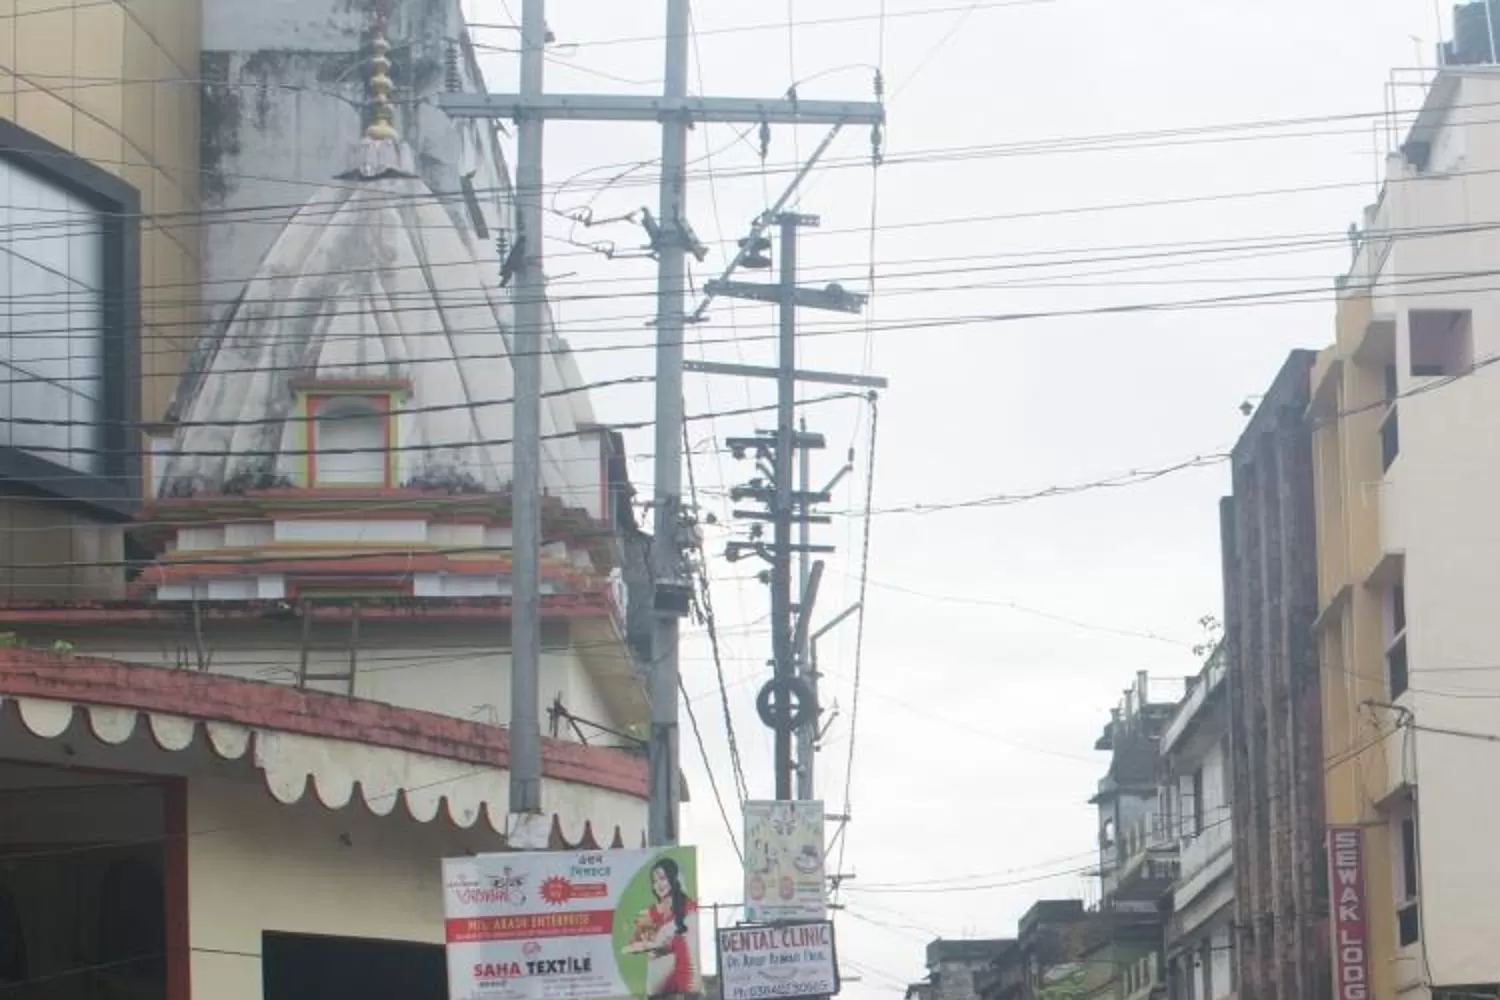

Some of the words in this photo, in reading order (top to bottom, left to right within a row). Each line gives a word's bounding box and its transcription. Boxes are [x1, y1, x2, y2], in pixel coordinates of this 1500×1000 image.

[1335, 831, 1360, 921] SEWAK
[721, 930, 779, 953] DENTAL
[782, 926, 829, 948] CLINIC
[474, 962, 521, 977] SAHA
[526, 957, 592, 975] TEXTILE
